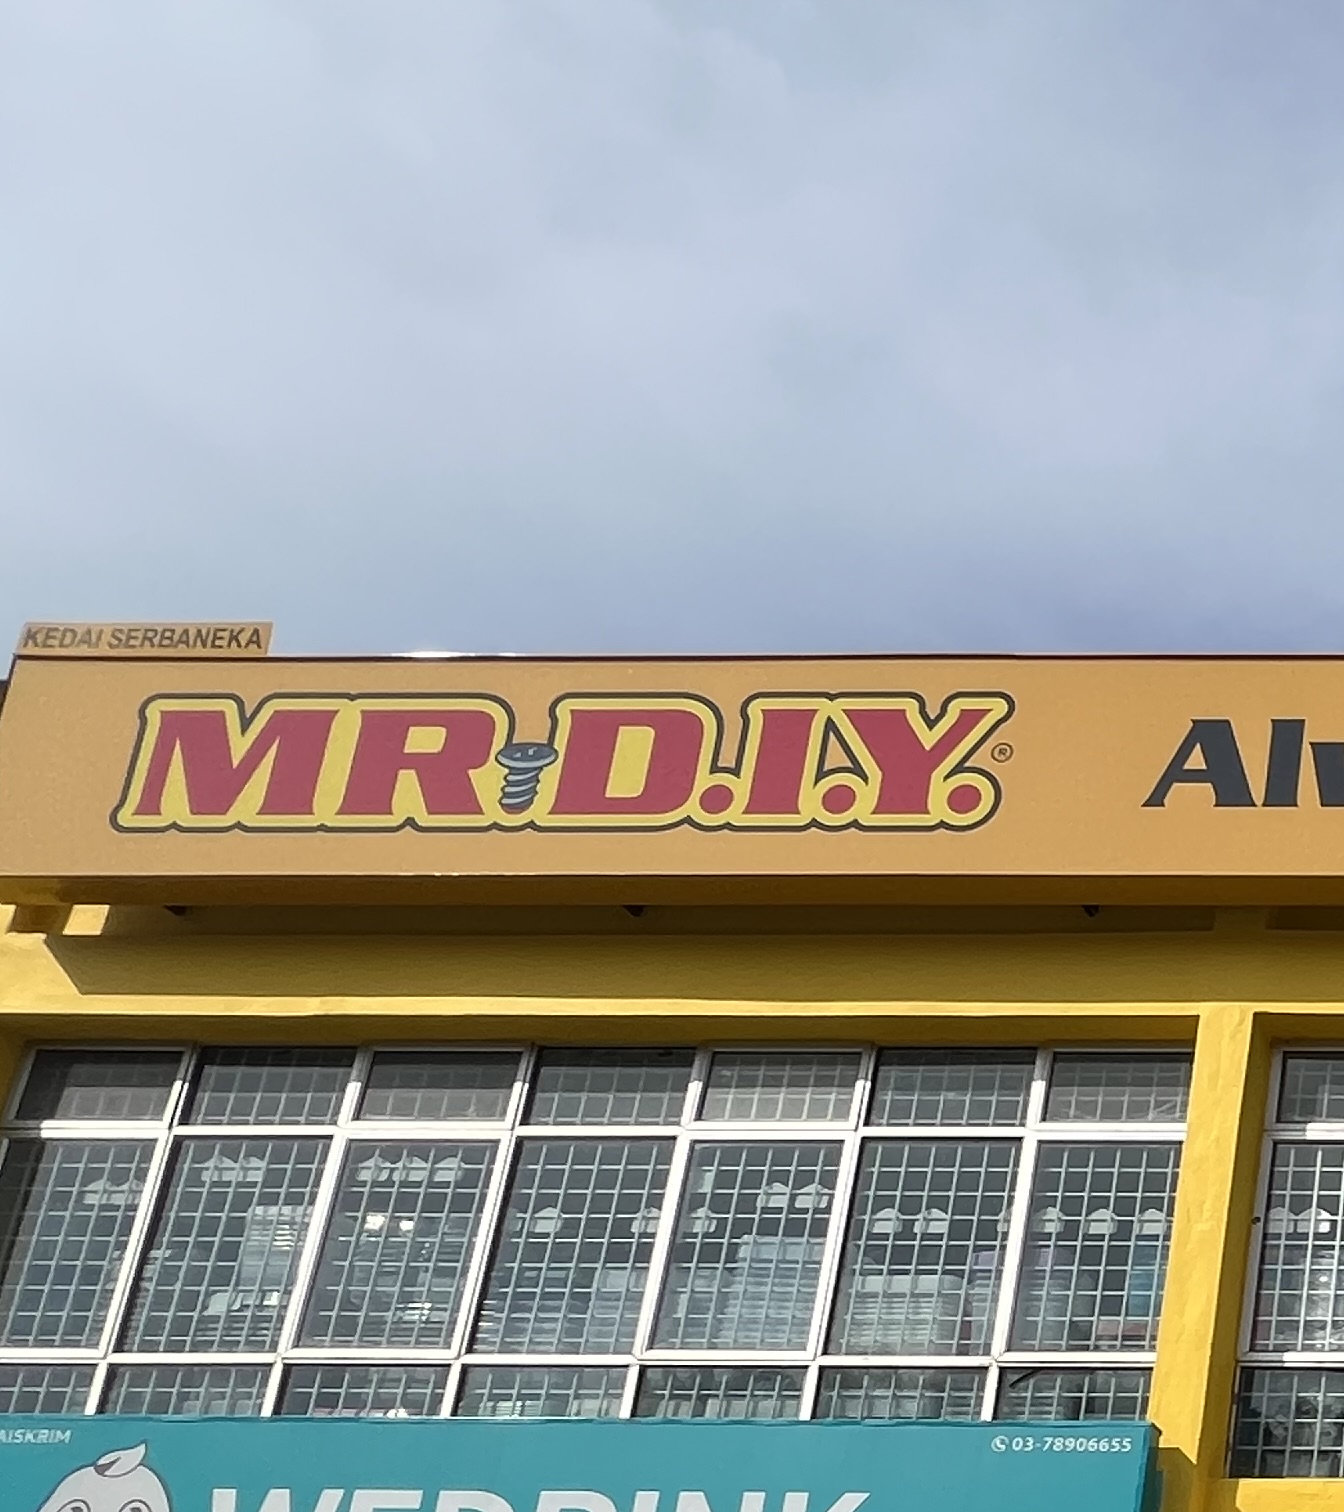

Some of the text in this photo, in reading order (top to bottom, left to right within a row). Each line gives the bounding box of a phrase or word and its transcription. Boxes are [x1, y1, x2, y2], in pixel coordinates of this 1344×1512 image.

[22, 627, 263, 650] KEDAI SERBANEKA
[1012, 1437, 1132, 1452] 03-78906655
